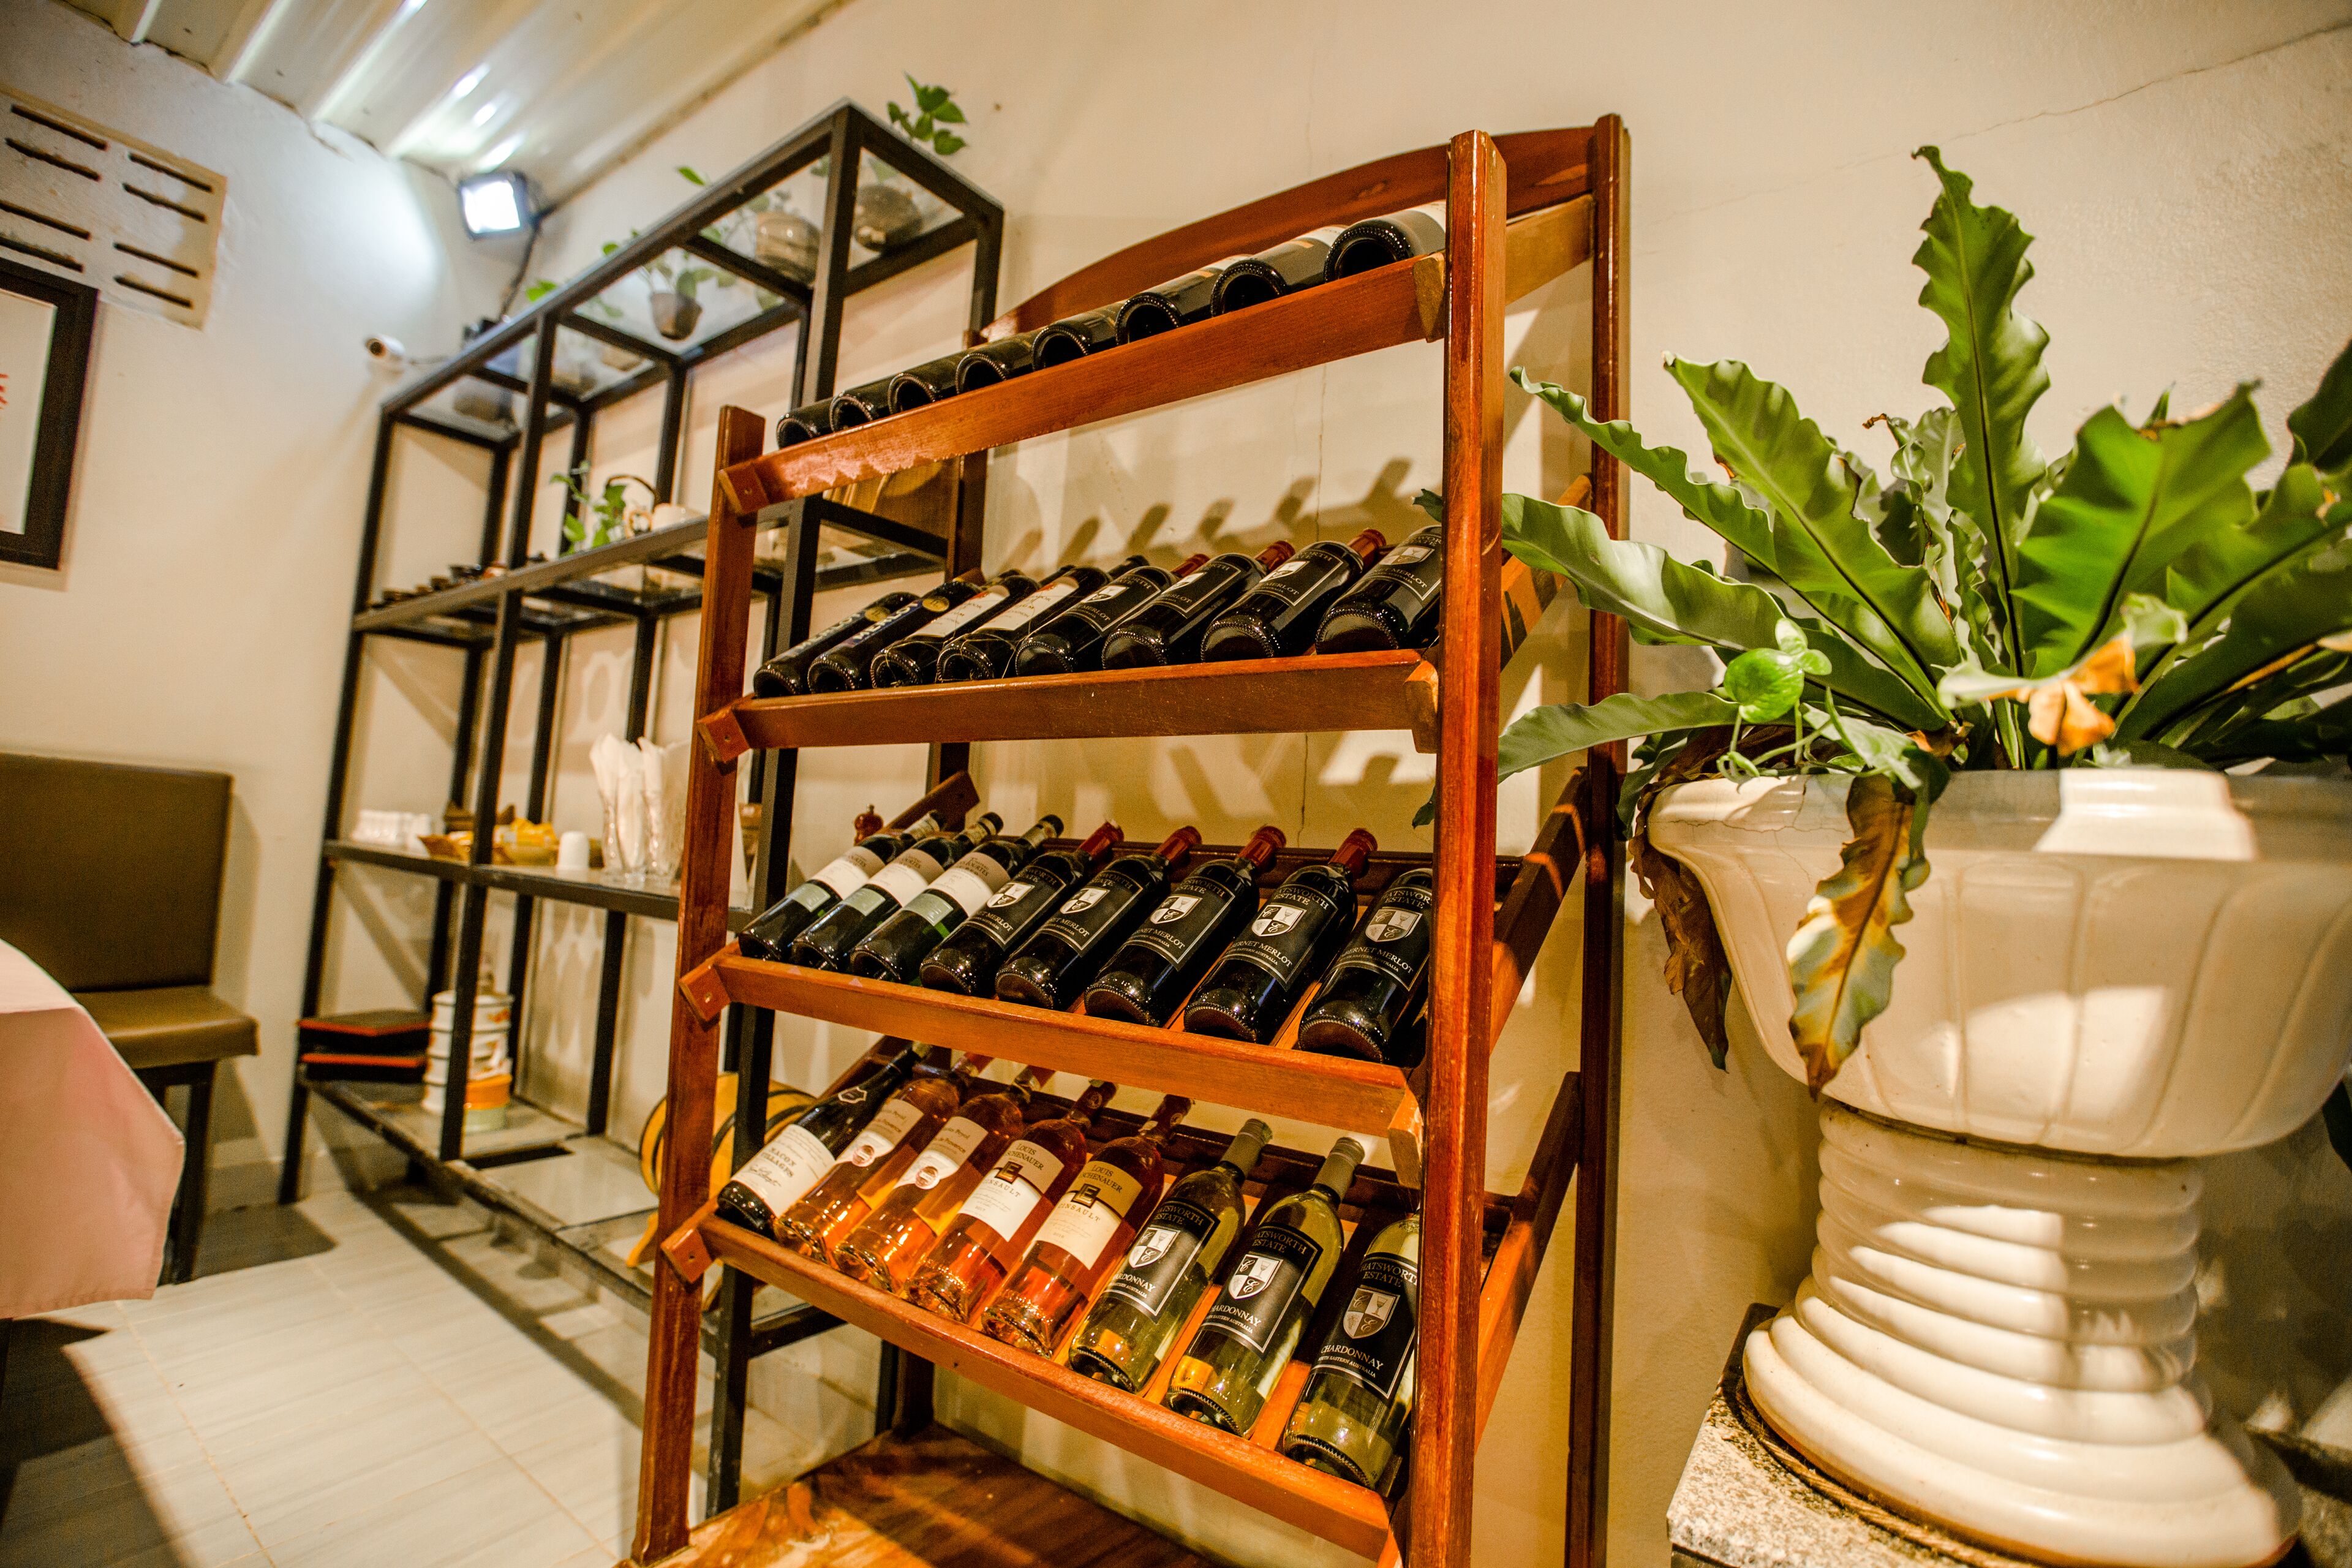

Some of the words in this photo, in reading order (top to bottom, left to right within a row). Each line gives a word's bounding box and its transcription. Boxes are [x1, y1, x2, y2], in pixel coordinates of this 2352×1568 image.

[1392, 568, 1427, 588] MERLOT
[1274, 894, 1310, 905] ESTATE
[1385, 897, 1425, 908] ESTATE
[986, 913, 1014, 932] MERLOT
[1060, 919, 1090, 937] MERLOT
[1153, 929, 1185, 949] MERLOT
[1254, 950, 1278, 965] AUSTRALIA
[1259, 943, 1292, 967] MERLOT
[1377, 949, 1414, 973] MERLOT
[1016, 1144, 1037, 1155] LOUIS
[1091, 1165, 1114, 1177] LOUIS
[1252, 1239, 1286, 1253] ESTATE
[1363, 1272, 1403, 1287] ESTATE
[1211, 1305, 1262, 1327] HARDONNAY
[1229, 1319, 1253, 1333] AUSTRALIA
[1321, 1344, 1384, 1370] CHARDONNAY
[1349, 1361, 1376, 1378] AUSTRALIA
